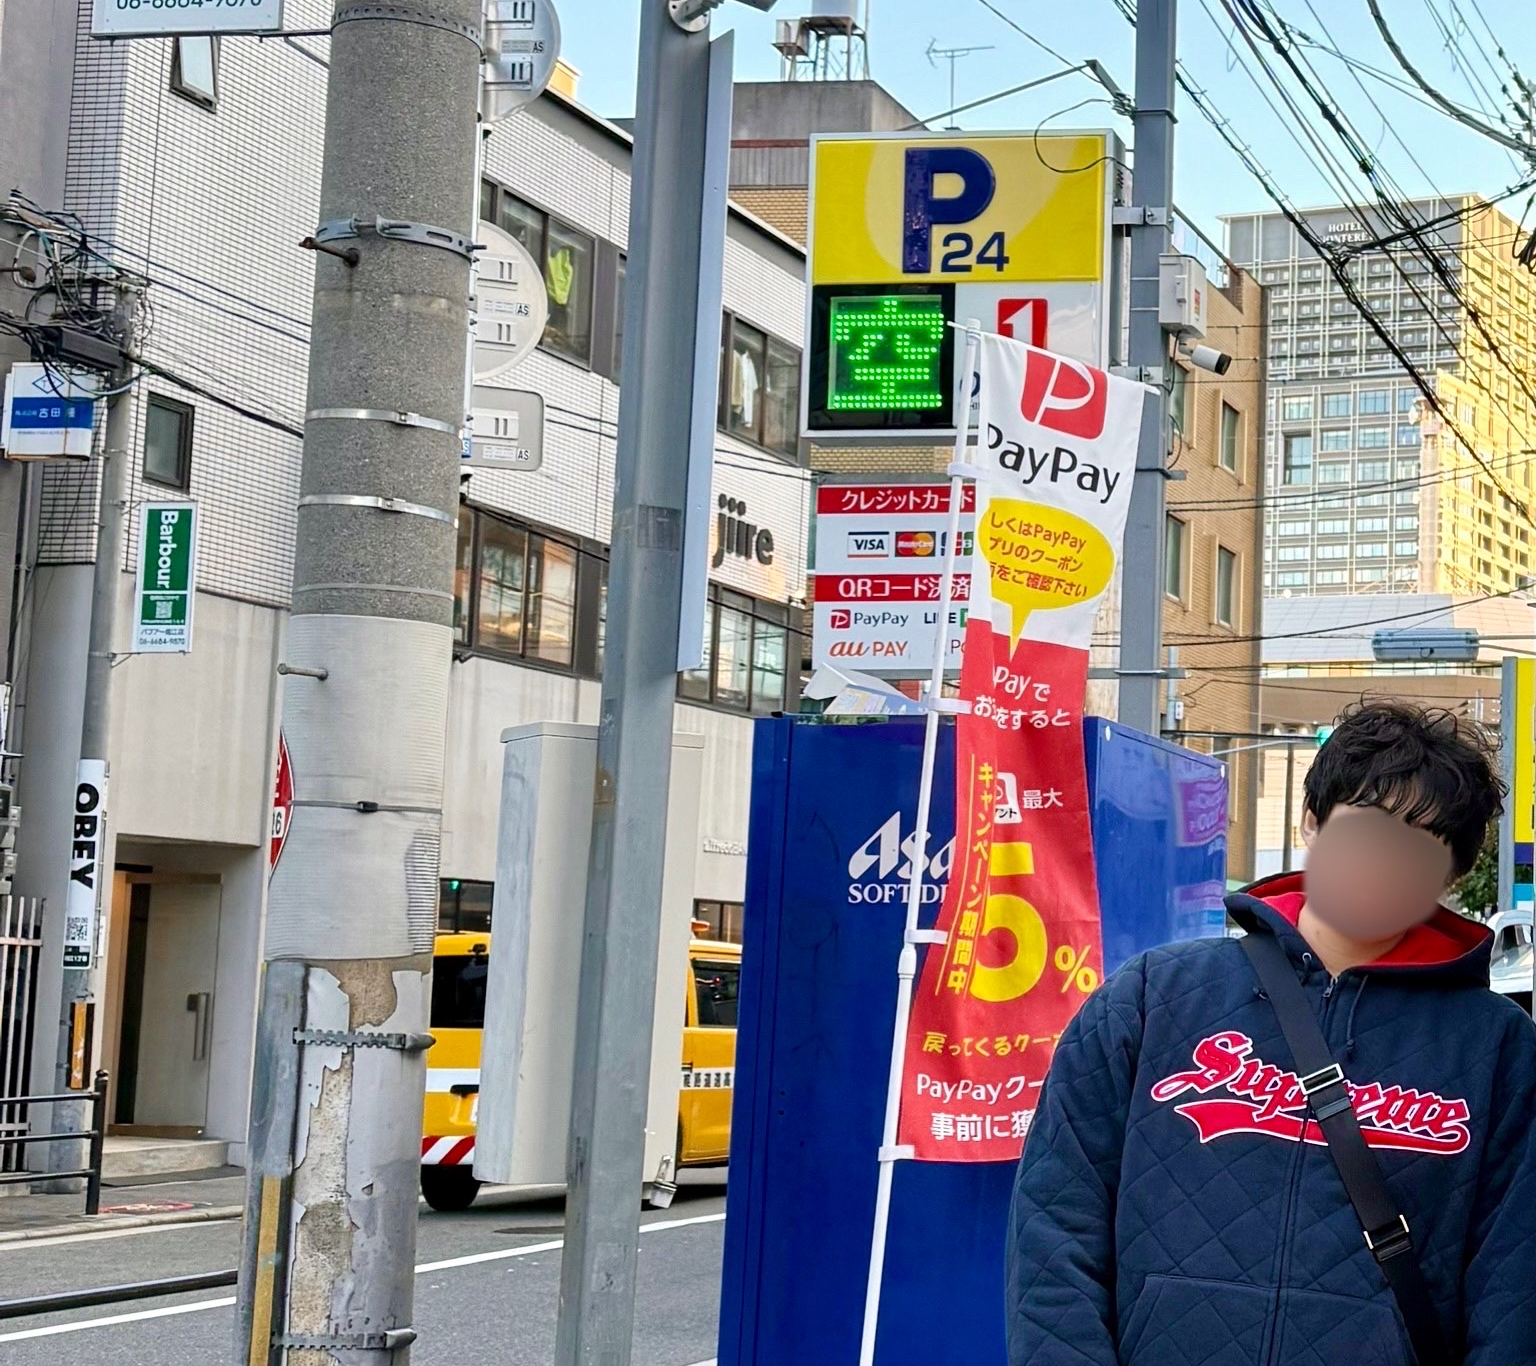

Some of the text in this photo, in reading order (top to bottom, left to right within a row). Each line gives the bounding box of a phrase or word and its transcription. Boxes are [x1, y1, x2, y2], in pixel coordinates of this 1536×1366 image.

[902, 147, 1010, 274] P 24
[834, 299, 944, 409] 空
[987, 423, 1121, 503] PayPay
[157, 511, 179, 590] Barbour
[854, 539, 885, 551] VISA
[829, 641, 908, 657] au PAY
[854, 612, 909, 627] PayPay
[70, 783, 99, 890] OBEY
[1022, 787, 1064, 809] 最大
[947, 762, 994, 995] キャンペーン期間中
[1151, 1031, 1471, 1141] Supeme
